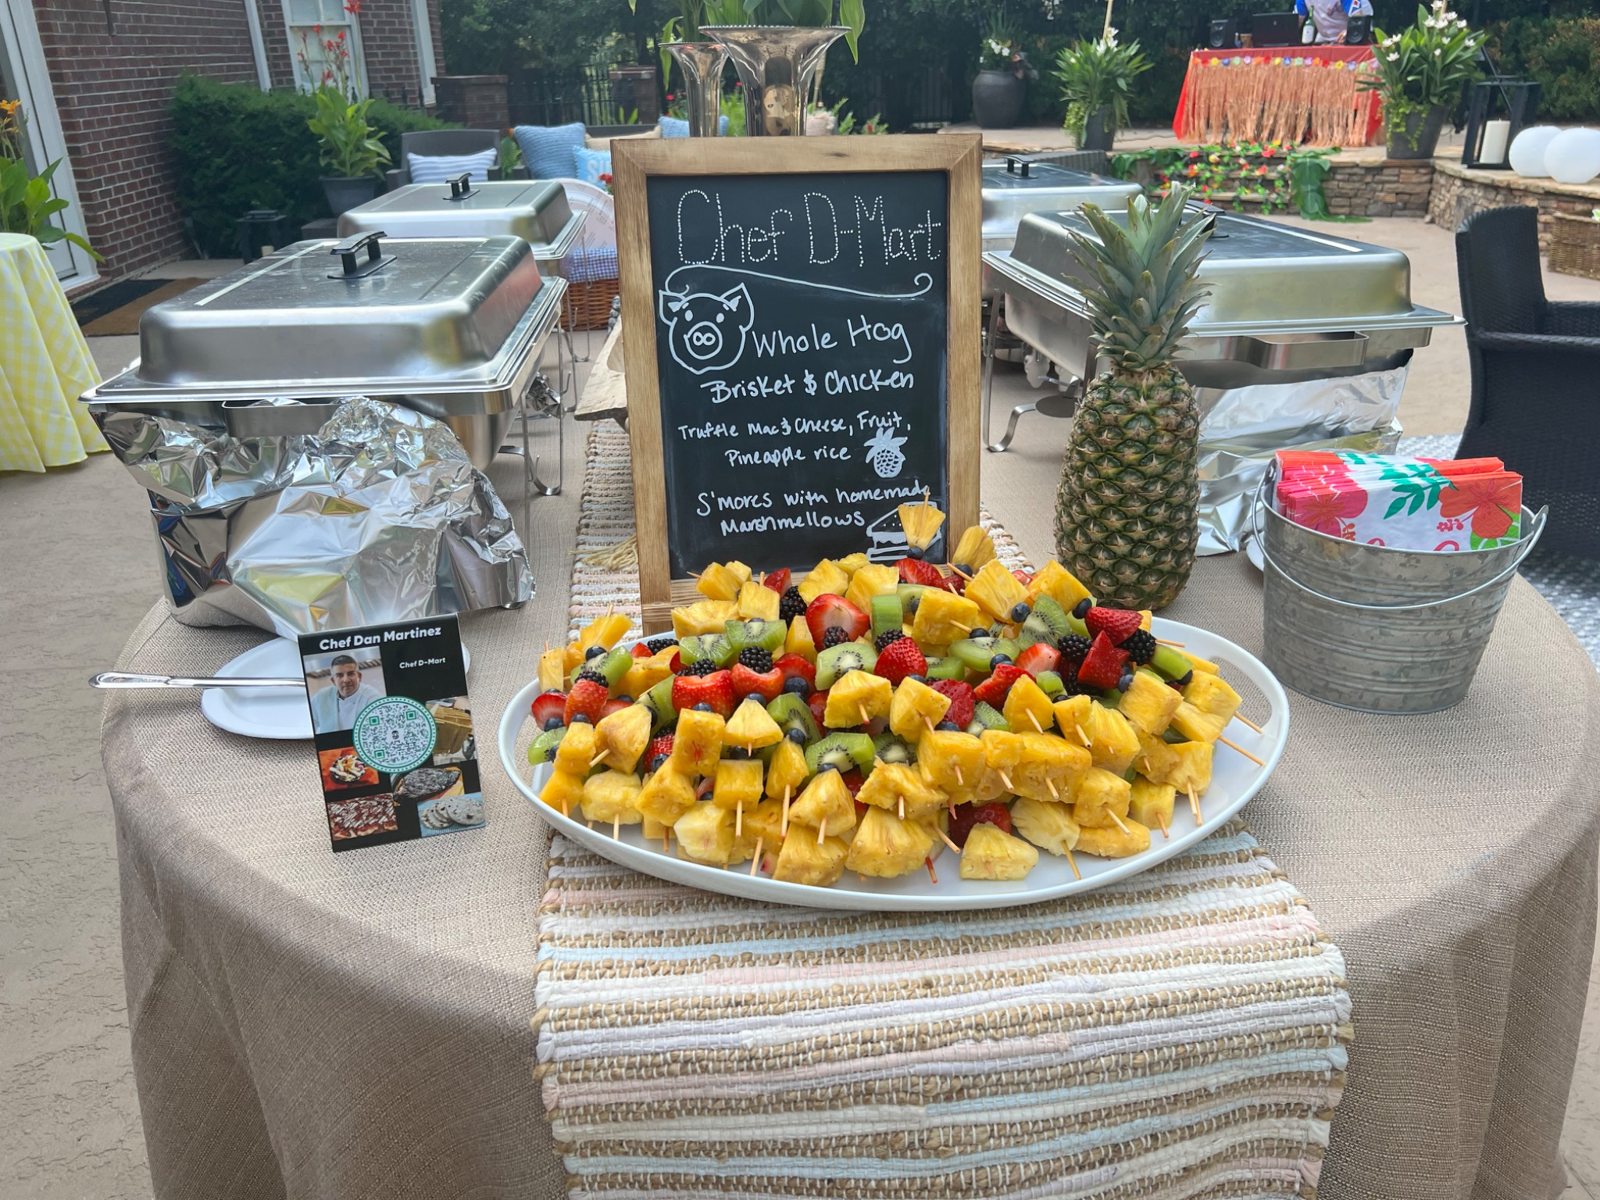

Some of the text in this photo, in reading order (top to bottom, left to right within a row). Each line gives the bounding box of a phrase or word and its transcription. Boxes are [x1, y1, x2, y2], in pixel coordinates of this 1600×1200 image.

[678, 190, 942, 267] Chef D-Mart
[752, 315, 912, 363] Whole Hog
[700, 373, 796, 403] Brisket
[825, 368, 914, 395] Chicken
[678, 423, 739, 440] Truffle
[857, 410, 911, 431] Fruit,
[725, 445, 851, 467] Pineapple rice
[697, 490, 773, 516] S'mores
[784, 490, 829, 506] with
[720, 510, 865, 536] Marshmellows
[319, 626, 442, 650] Chef Dan Martinez
[399, 657, 446, 669] Chef D-Mart
